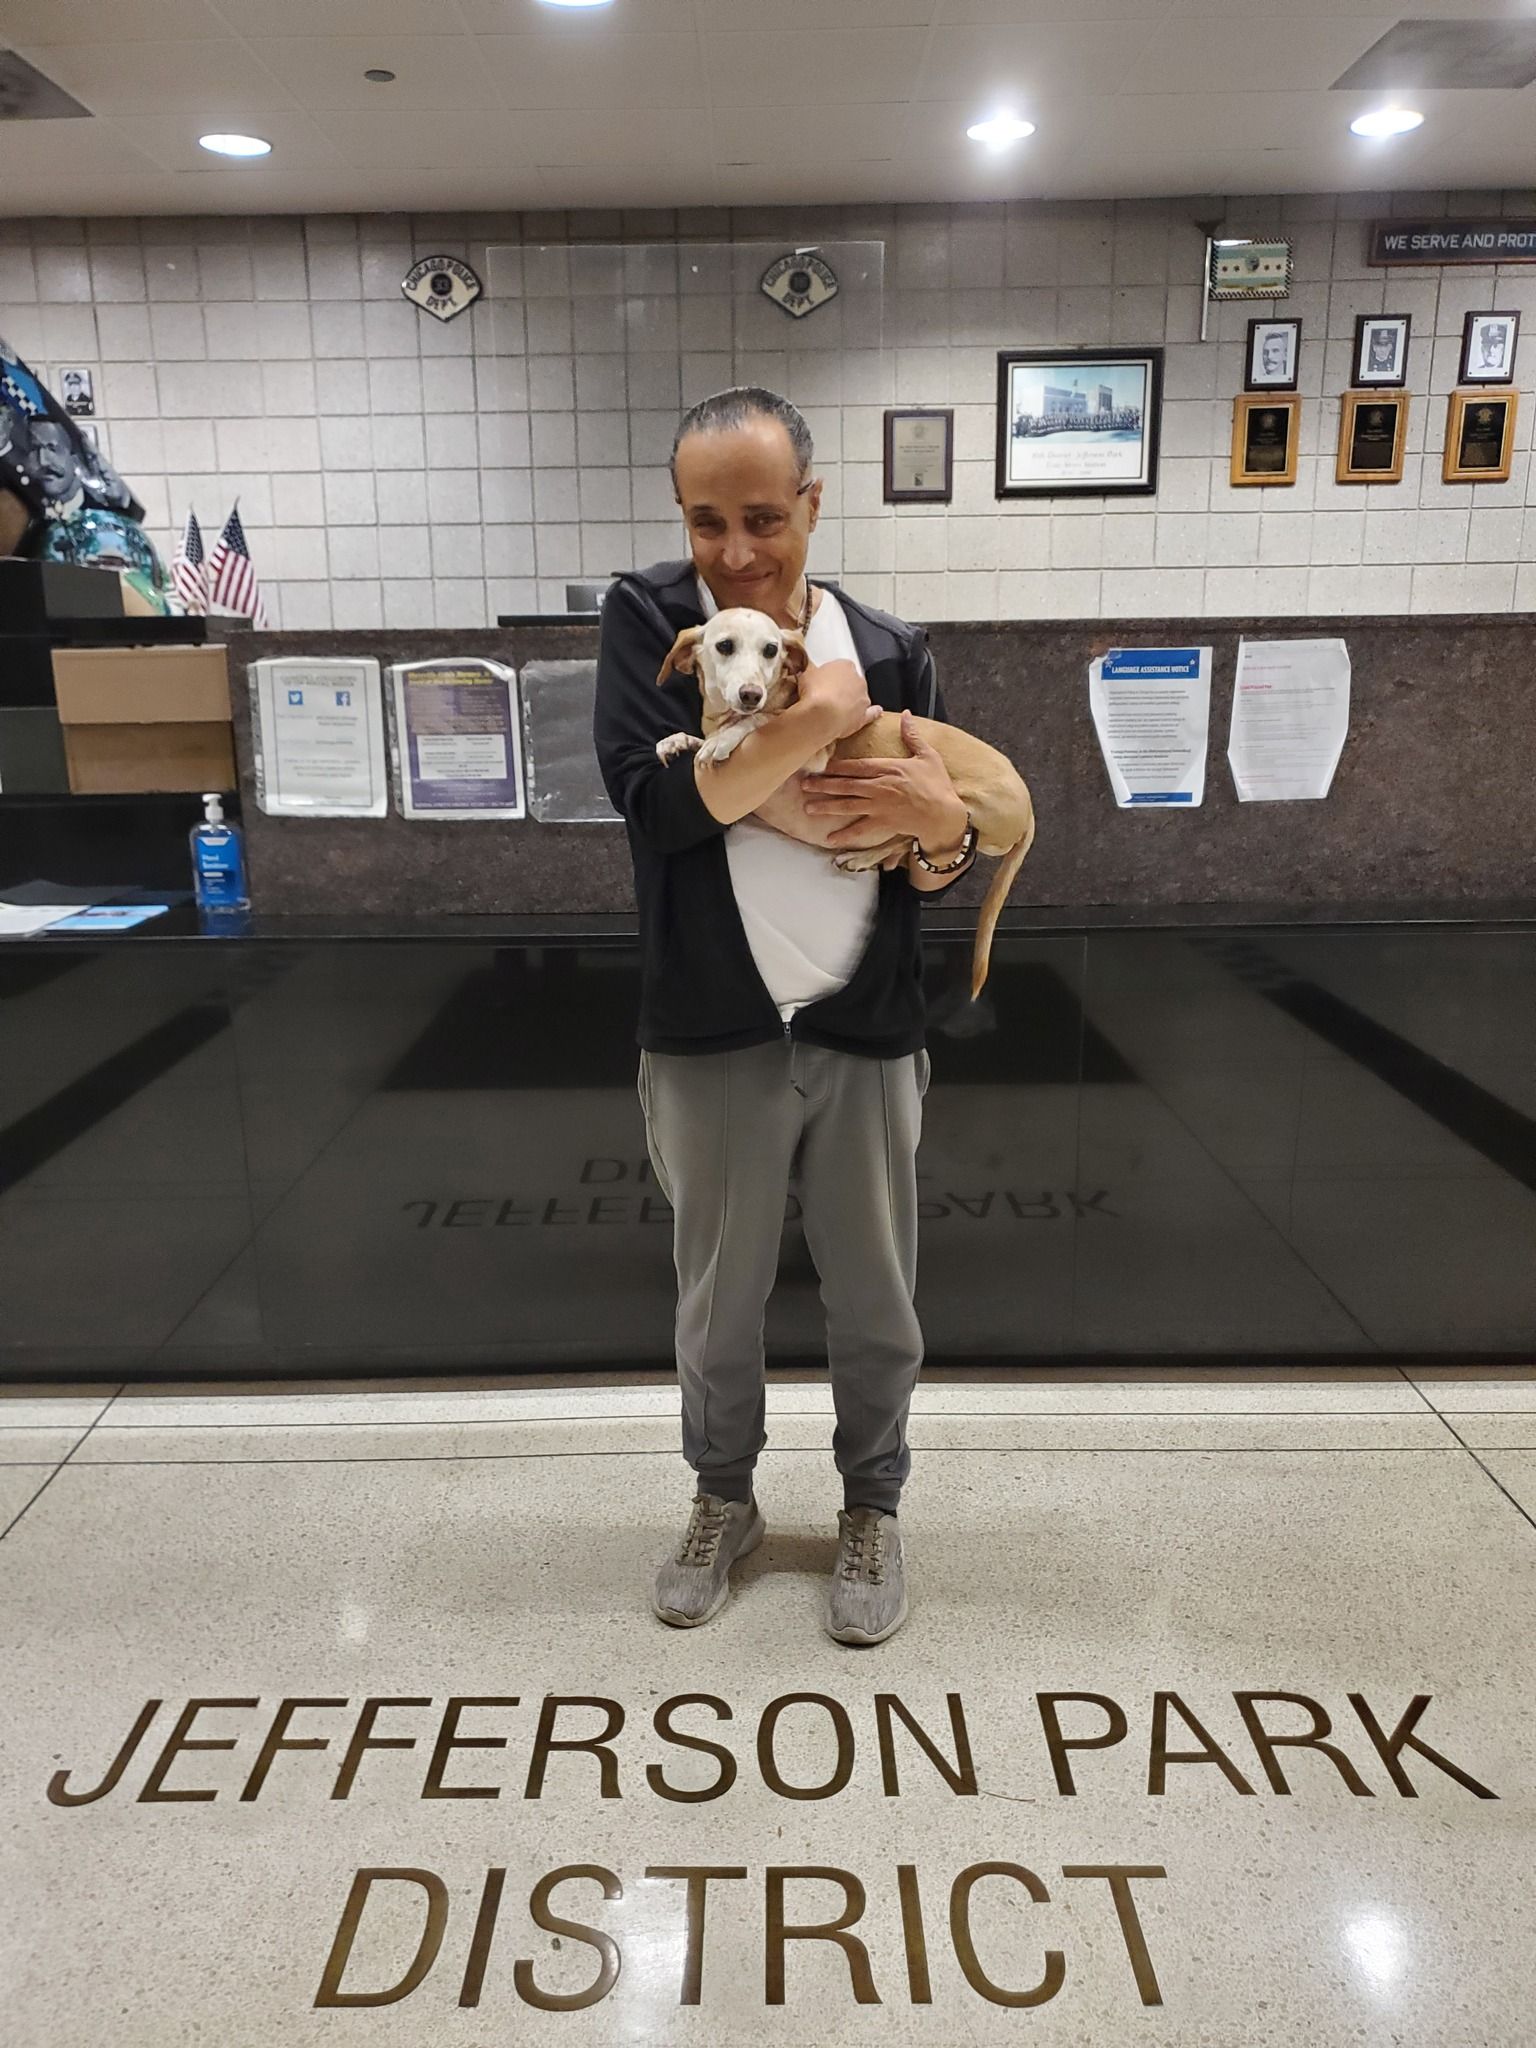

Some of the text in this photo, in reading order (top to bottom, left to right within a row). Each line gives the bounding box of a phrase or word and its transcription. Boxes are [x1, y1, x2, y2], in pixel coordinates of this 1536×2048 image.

[1384, 235, 1407, 249] WE
[1410, 234, 1460, 249] SERVE
[1461, 233, 1495, 248] AND
[47, 1692, 1500, 1809] JEFFERSON PARK
[312, 1862, 1168, 2013] DISTRICT
